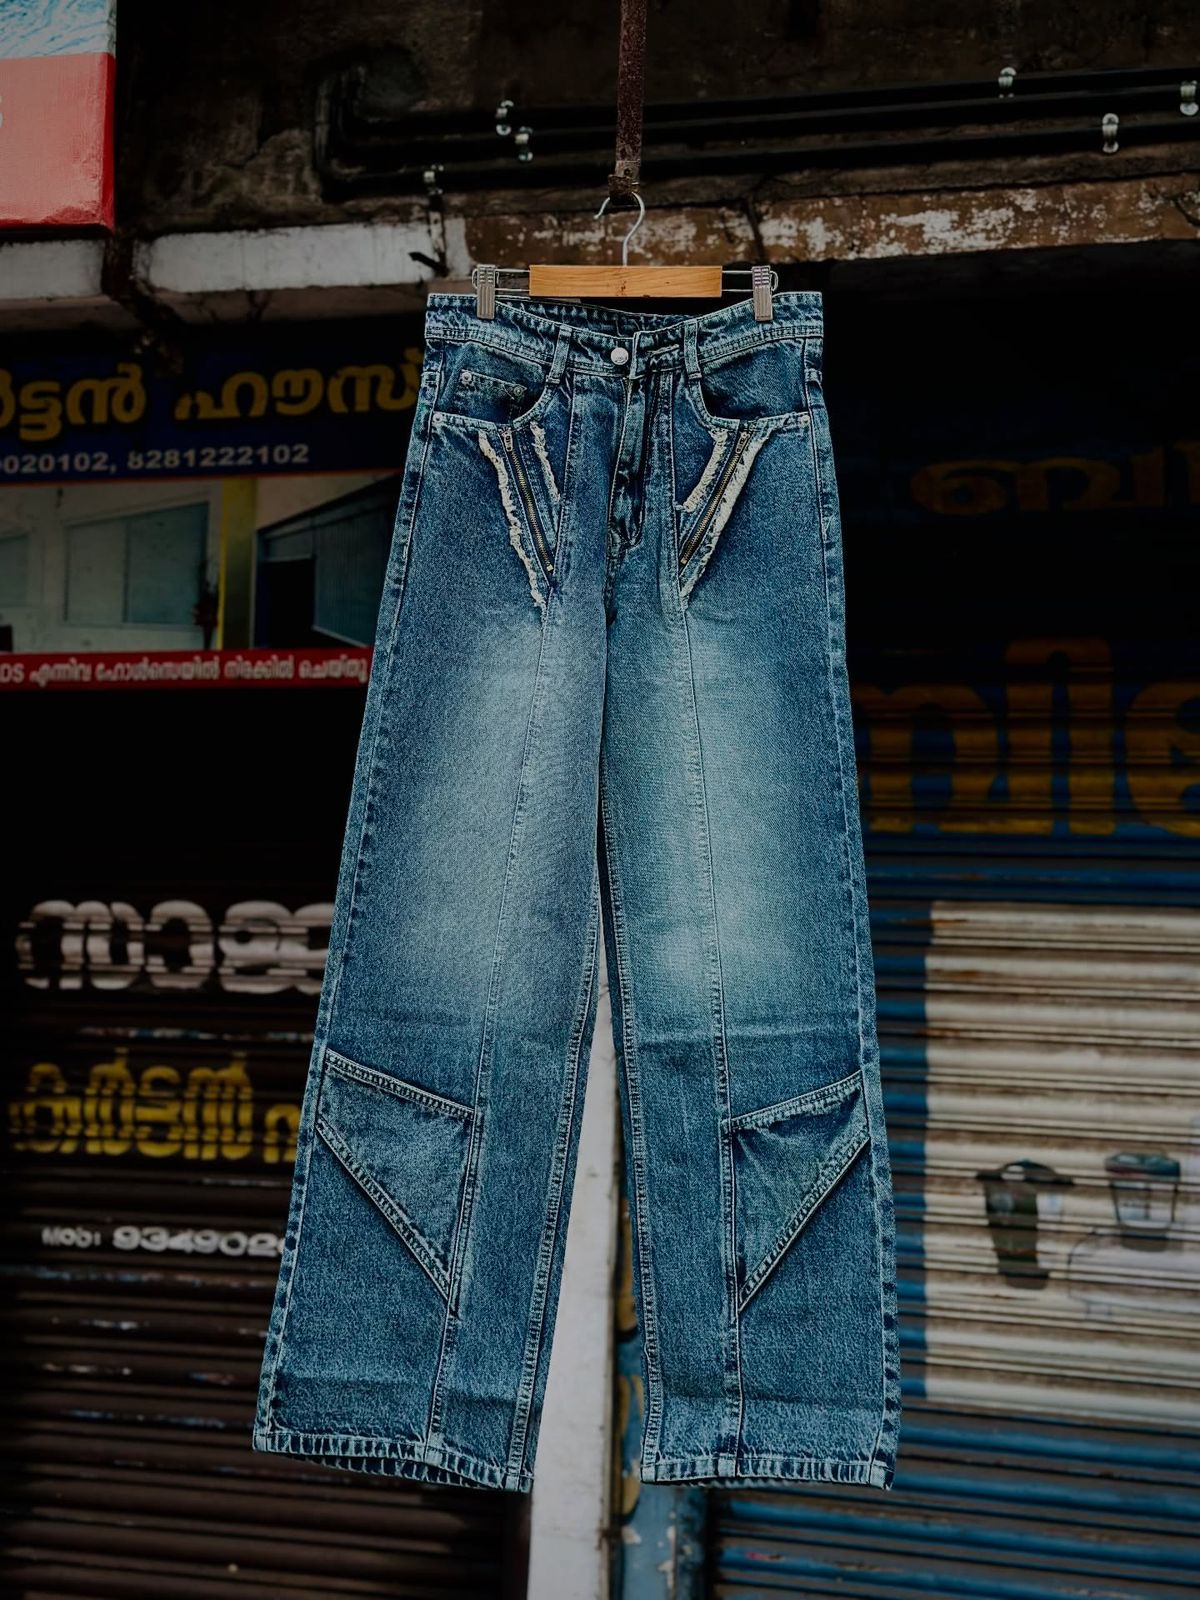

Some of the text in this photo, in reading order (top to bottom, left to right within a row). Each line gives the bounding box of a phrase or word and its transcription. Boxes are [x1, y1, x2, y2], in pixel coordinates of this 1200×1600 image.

[0, 360, 147, 443] ട്ടൻ
[0, 443, 310, 475] 020102, 8281222102
[112, 1226, 286, 1258] 934902
